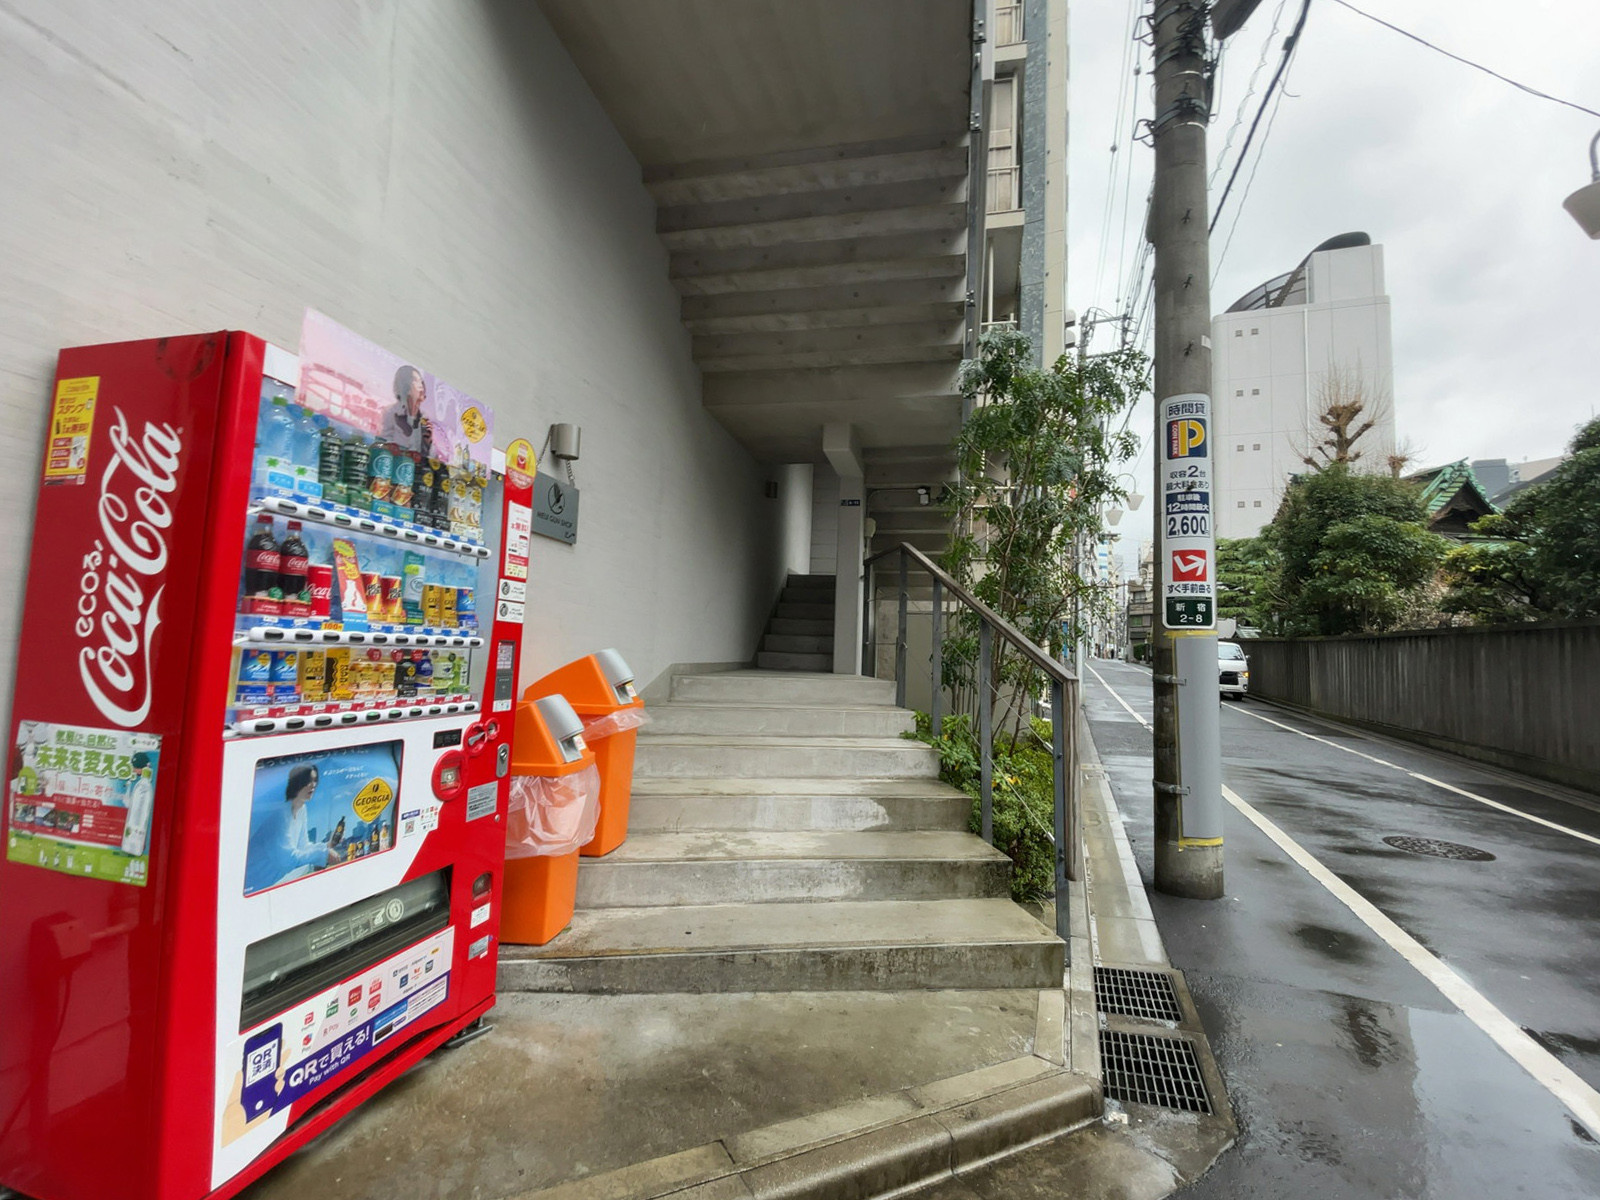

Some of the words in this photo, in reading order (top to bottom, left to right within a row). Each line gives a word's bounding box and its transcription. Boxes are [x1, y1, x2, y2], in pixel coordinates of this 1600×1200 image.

[1168, 402, 1206, 416] 時間貸
[1169, 465, 1206, 479] 収容2台
[79, 405, 182, 729] Coca-Cola
[1180, 613, 1203, 623] 2-8
[355, 794, 390, 807] GEORGIA
[253, 1048, 272, 1065] QR
[289, 1025, 370, 1087] QRで買える!
[309, 1073, 322, 1085] Pay
[324, 1062, 339, 1075] with
